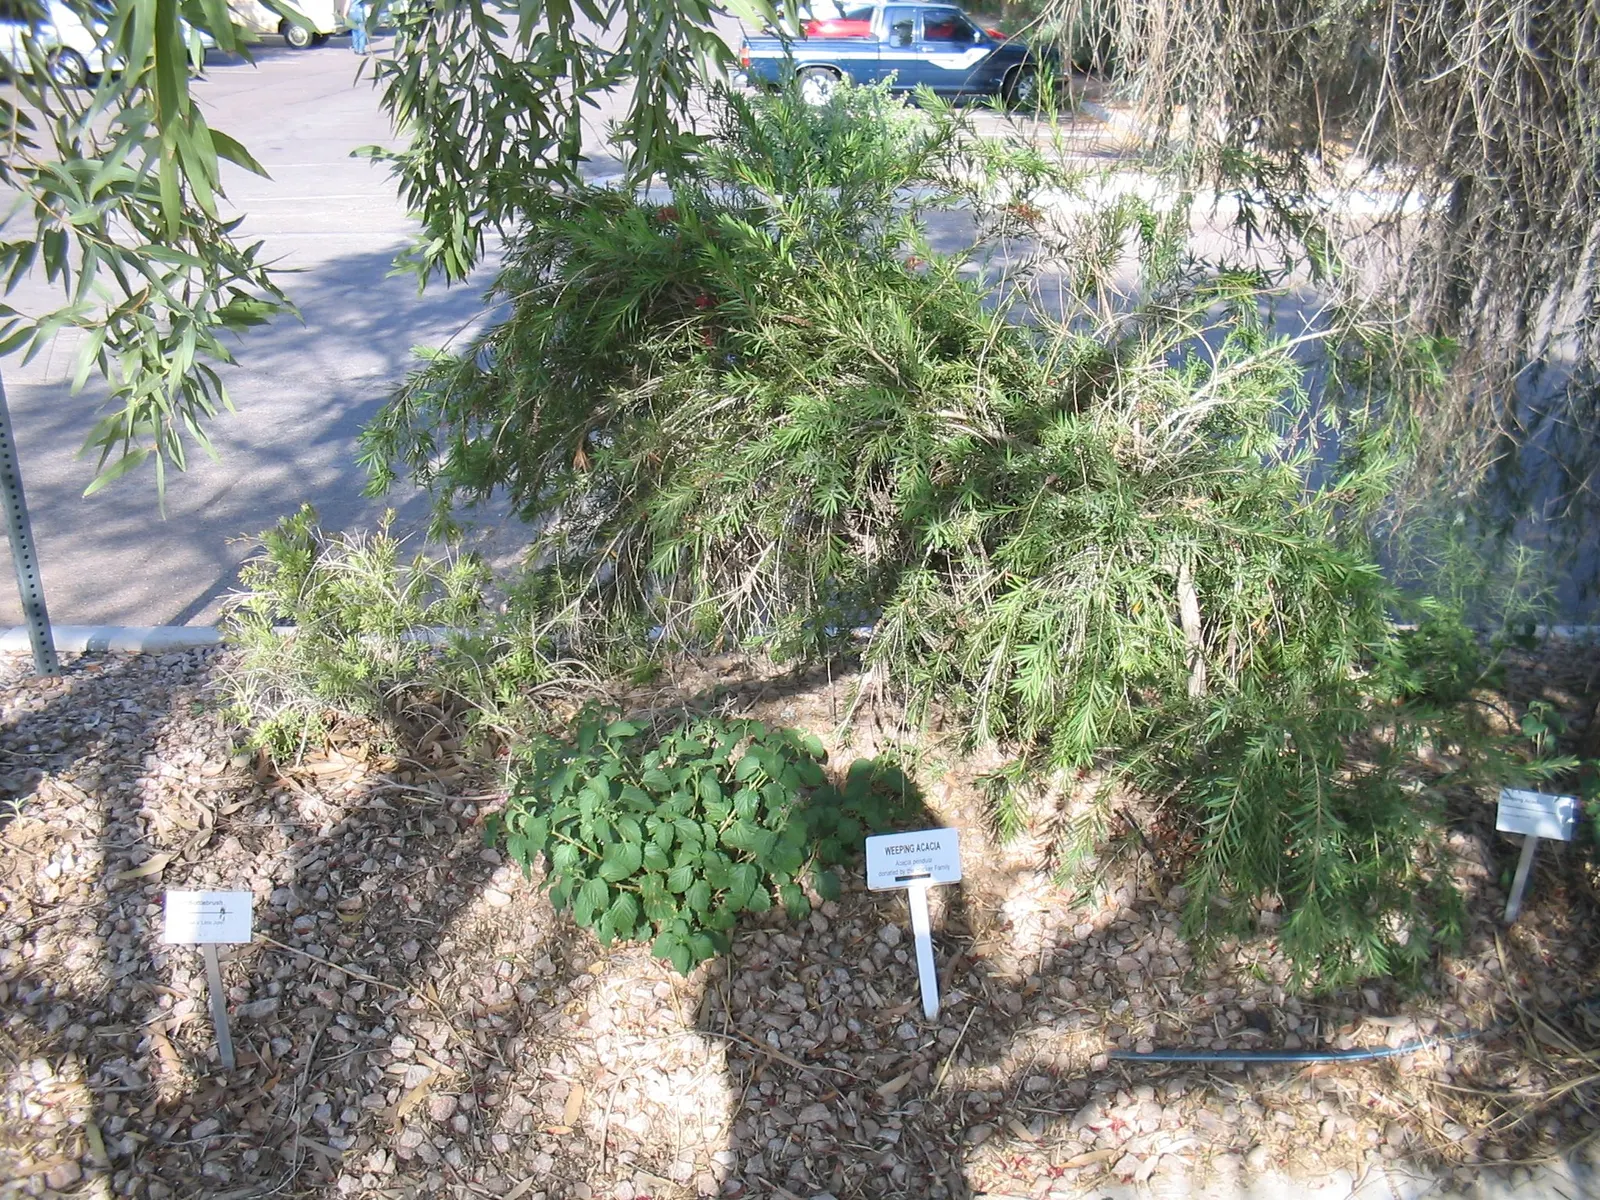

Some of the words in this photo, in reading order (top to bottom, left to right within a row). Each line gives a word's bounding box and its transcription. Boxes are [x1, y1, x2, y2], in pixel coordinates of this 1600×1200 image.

[884, 844, 915, 856] WEEPING
[916, 841, 941, 852] ACACIA
[878, 868, 899, 877] donated
[899, 868, 906, 876] by
[934, 864, 951, 872] Family
